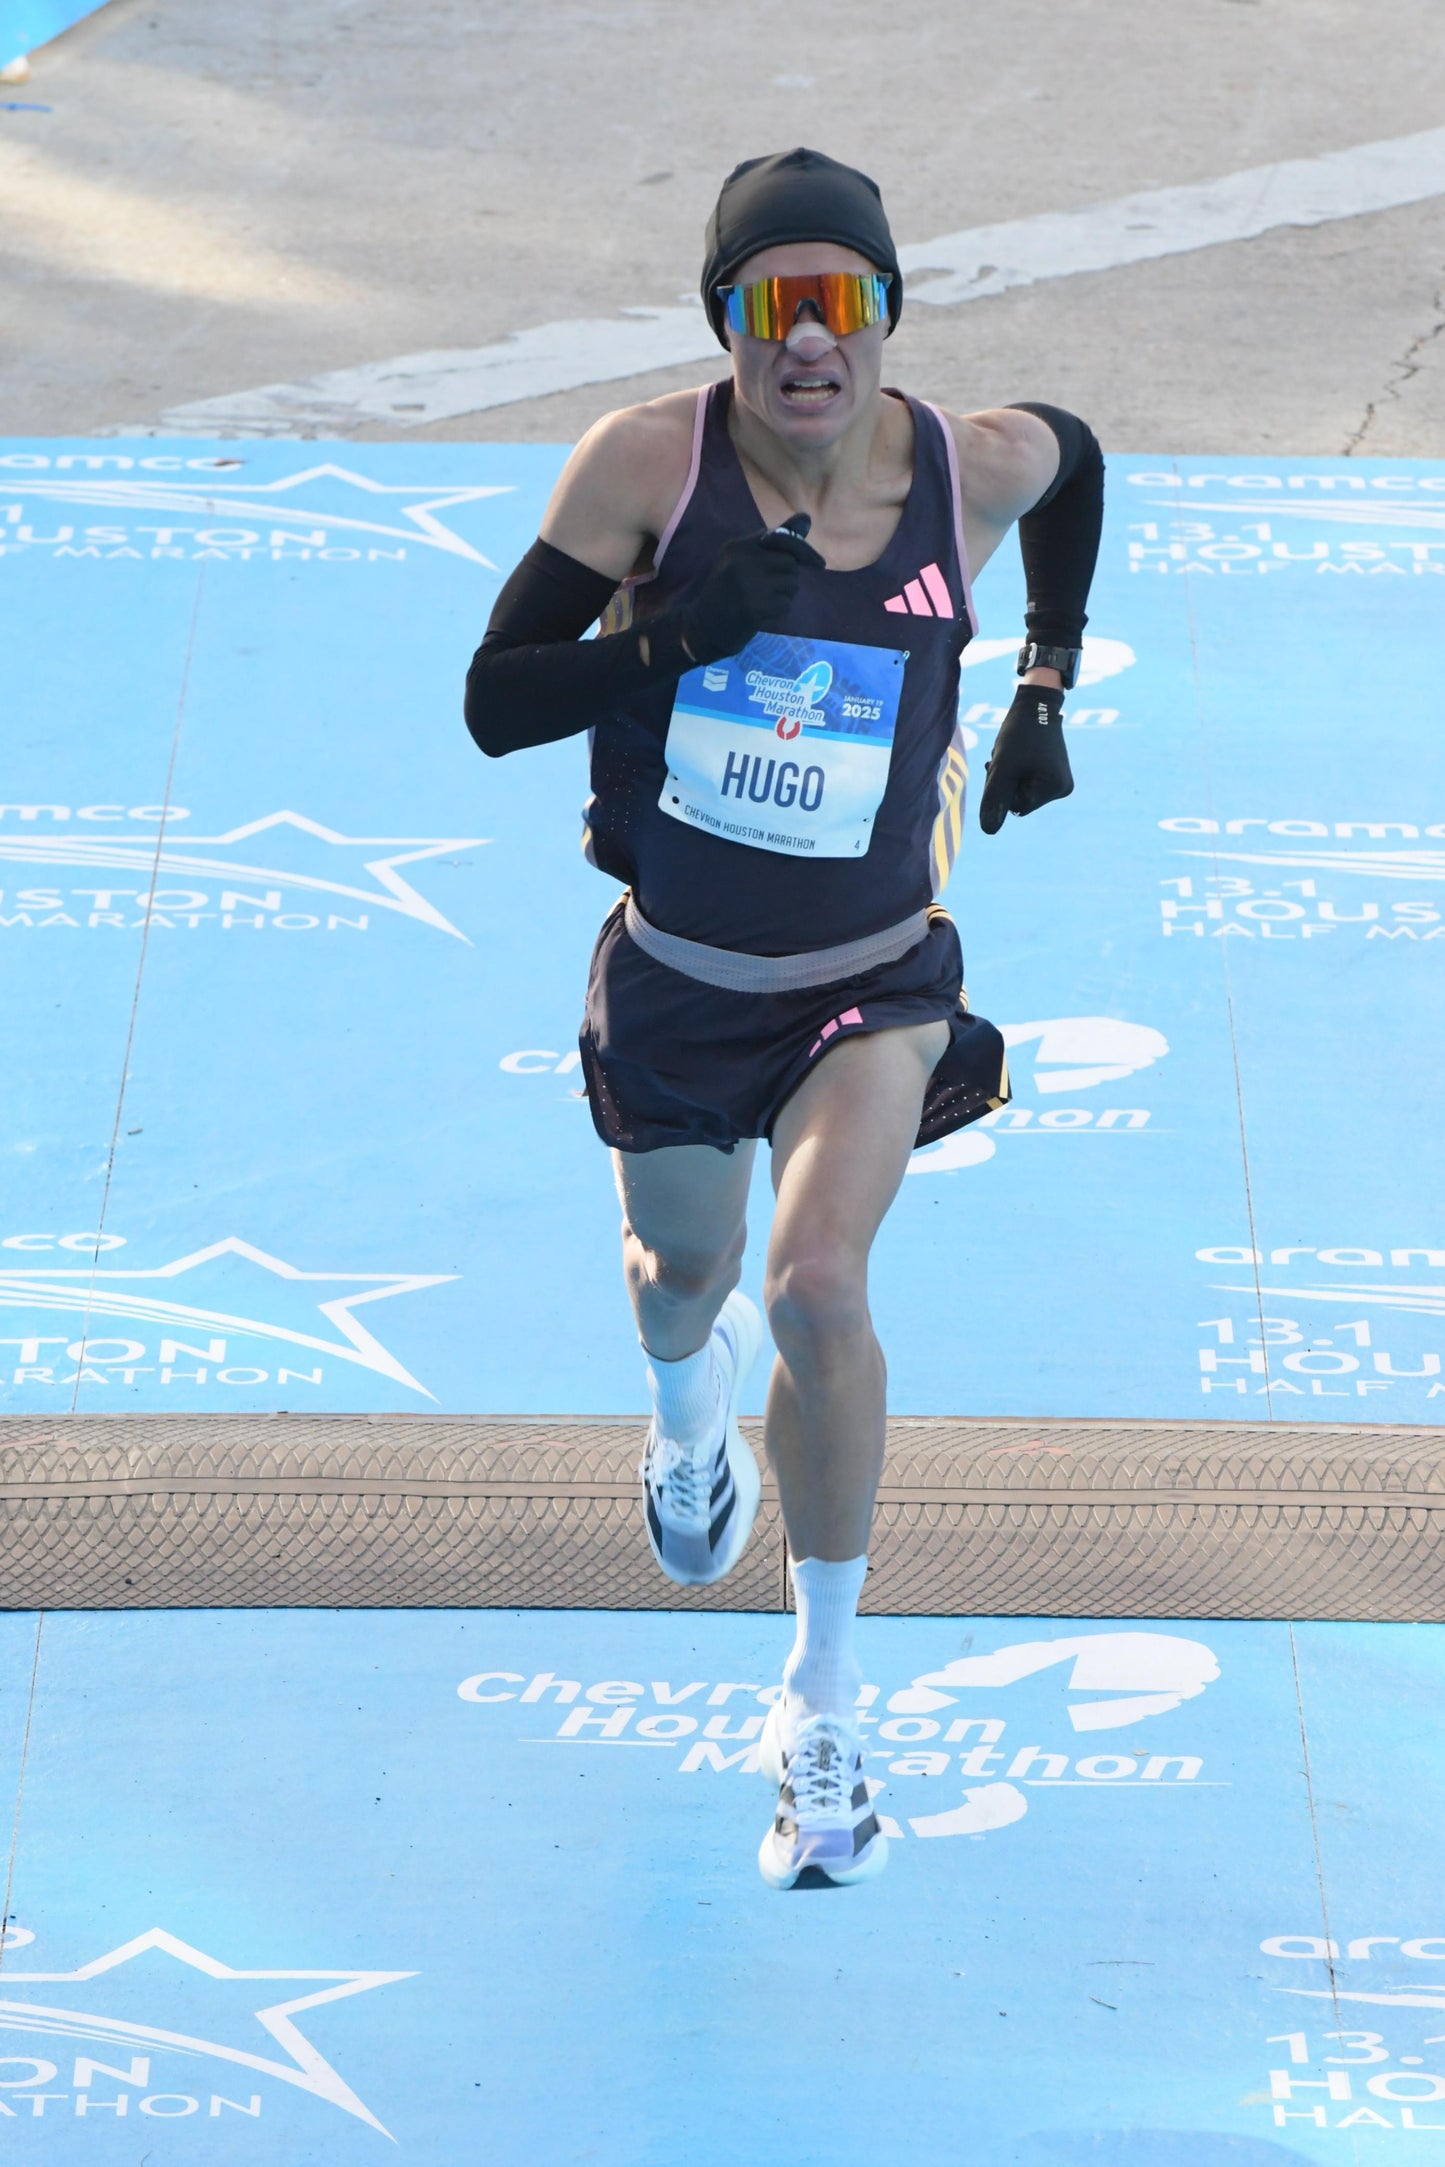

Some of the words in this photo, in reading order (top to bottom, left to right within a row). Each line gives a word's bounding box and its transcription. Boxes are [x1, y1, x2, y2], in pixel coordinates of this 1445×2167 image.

[0, 525, 327, 547] USTON
[1128, 522, 1273, 541] 13.1
[53, 544, 407, 561] MARATHON
[1129, 560, 1292, 575] HALF
[747, 672, 794, 690] Chevron
[755, 686, 804, 705] Houston
[844, 695, 875, 705] JANUARY
[765, 700, 823, 721] Marathon
[842, 703, 881, 720] 2025
[720, 751, 825, 812] HUGO
[684, 804, 721, 829] CHEVRON
[723, 822, 764, 841] HOUSTON
[766, 832, 816, 850] MARATHON
[854, 840, 860, 851] 4
[1158, 874, 1318, 899] 13.1
[0, 888, 284, 912] STON
[1160, 922, 1337, 939] HALF
[1196, 1317, 1372, 1347] 13.1
[0, 1367, 324, 1386] RATHON
[1200, 1377, 1396, 1397] HALF
